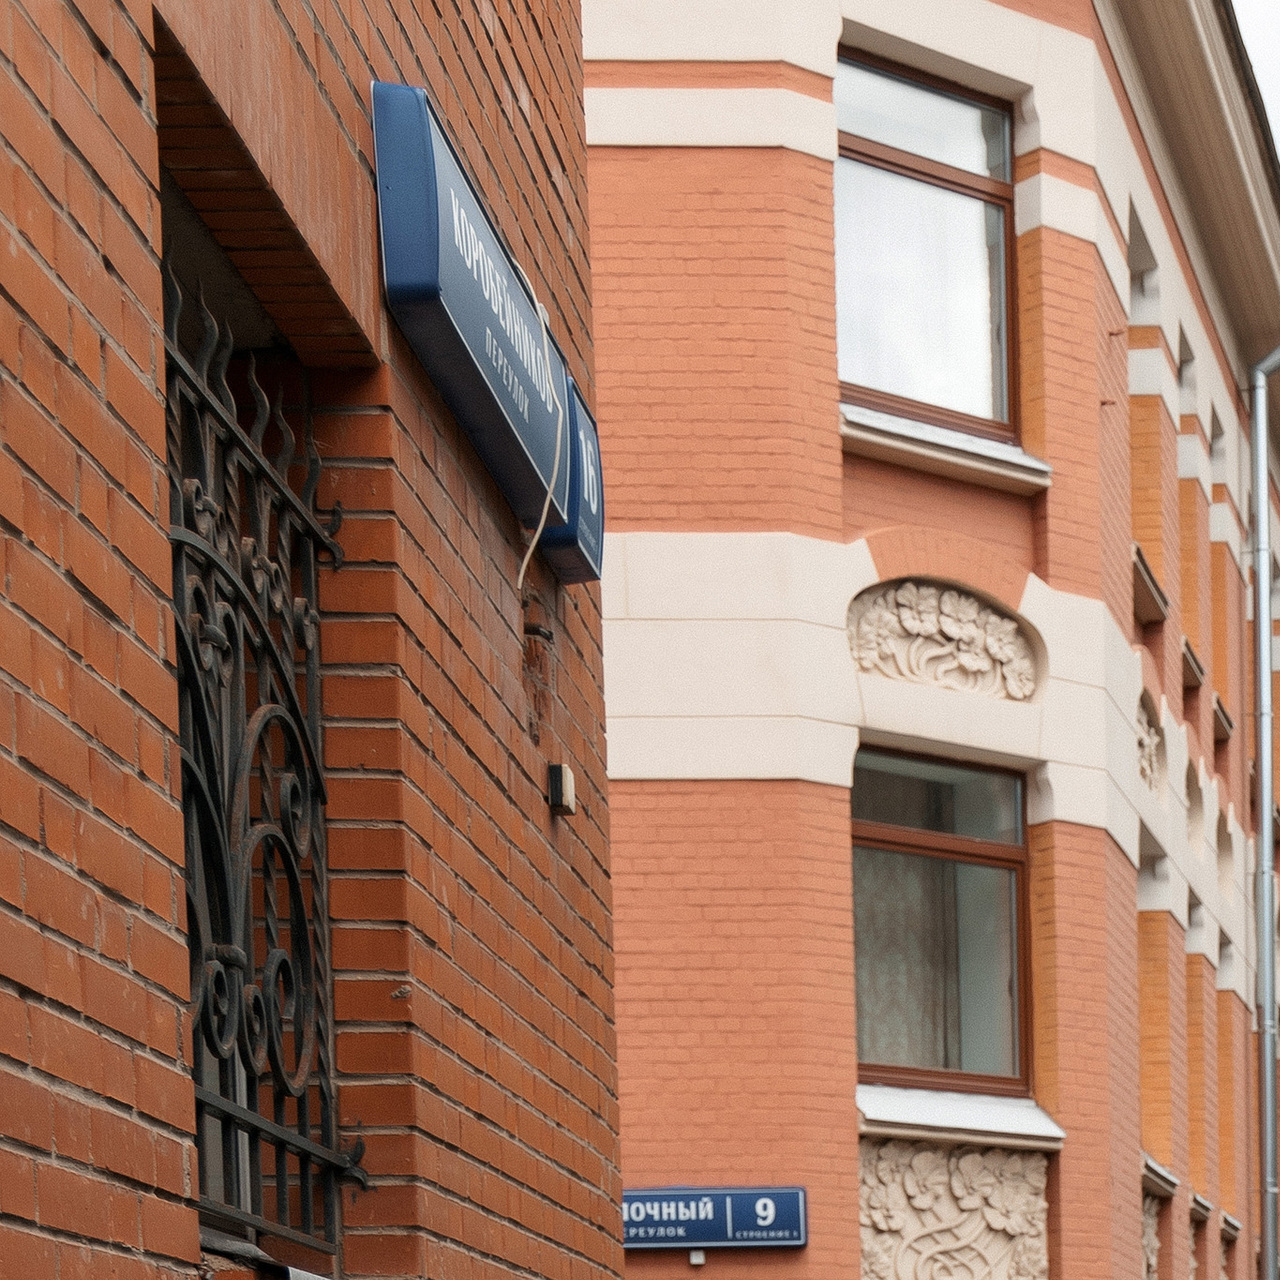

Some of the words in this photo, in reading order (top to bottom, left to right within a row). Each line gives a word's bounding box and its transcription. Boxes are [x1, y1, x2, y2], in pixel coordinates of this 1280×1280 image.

[450, 187, 554, 414] КОРОБЕЙНИКОВ
[485, 326, 530, 424] ПЕРЕУЛОК
[578, 429, 598, 516] 16
[754, 1197, 776, 1227] 9
